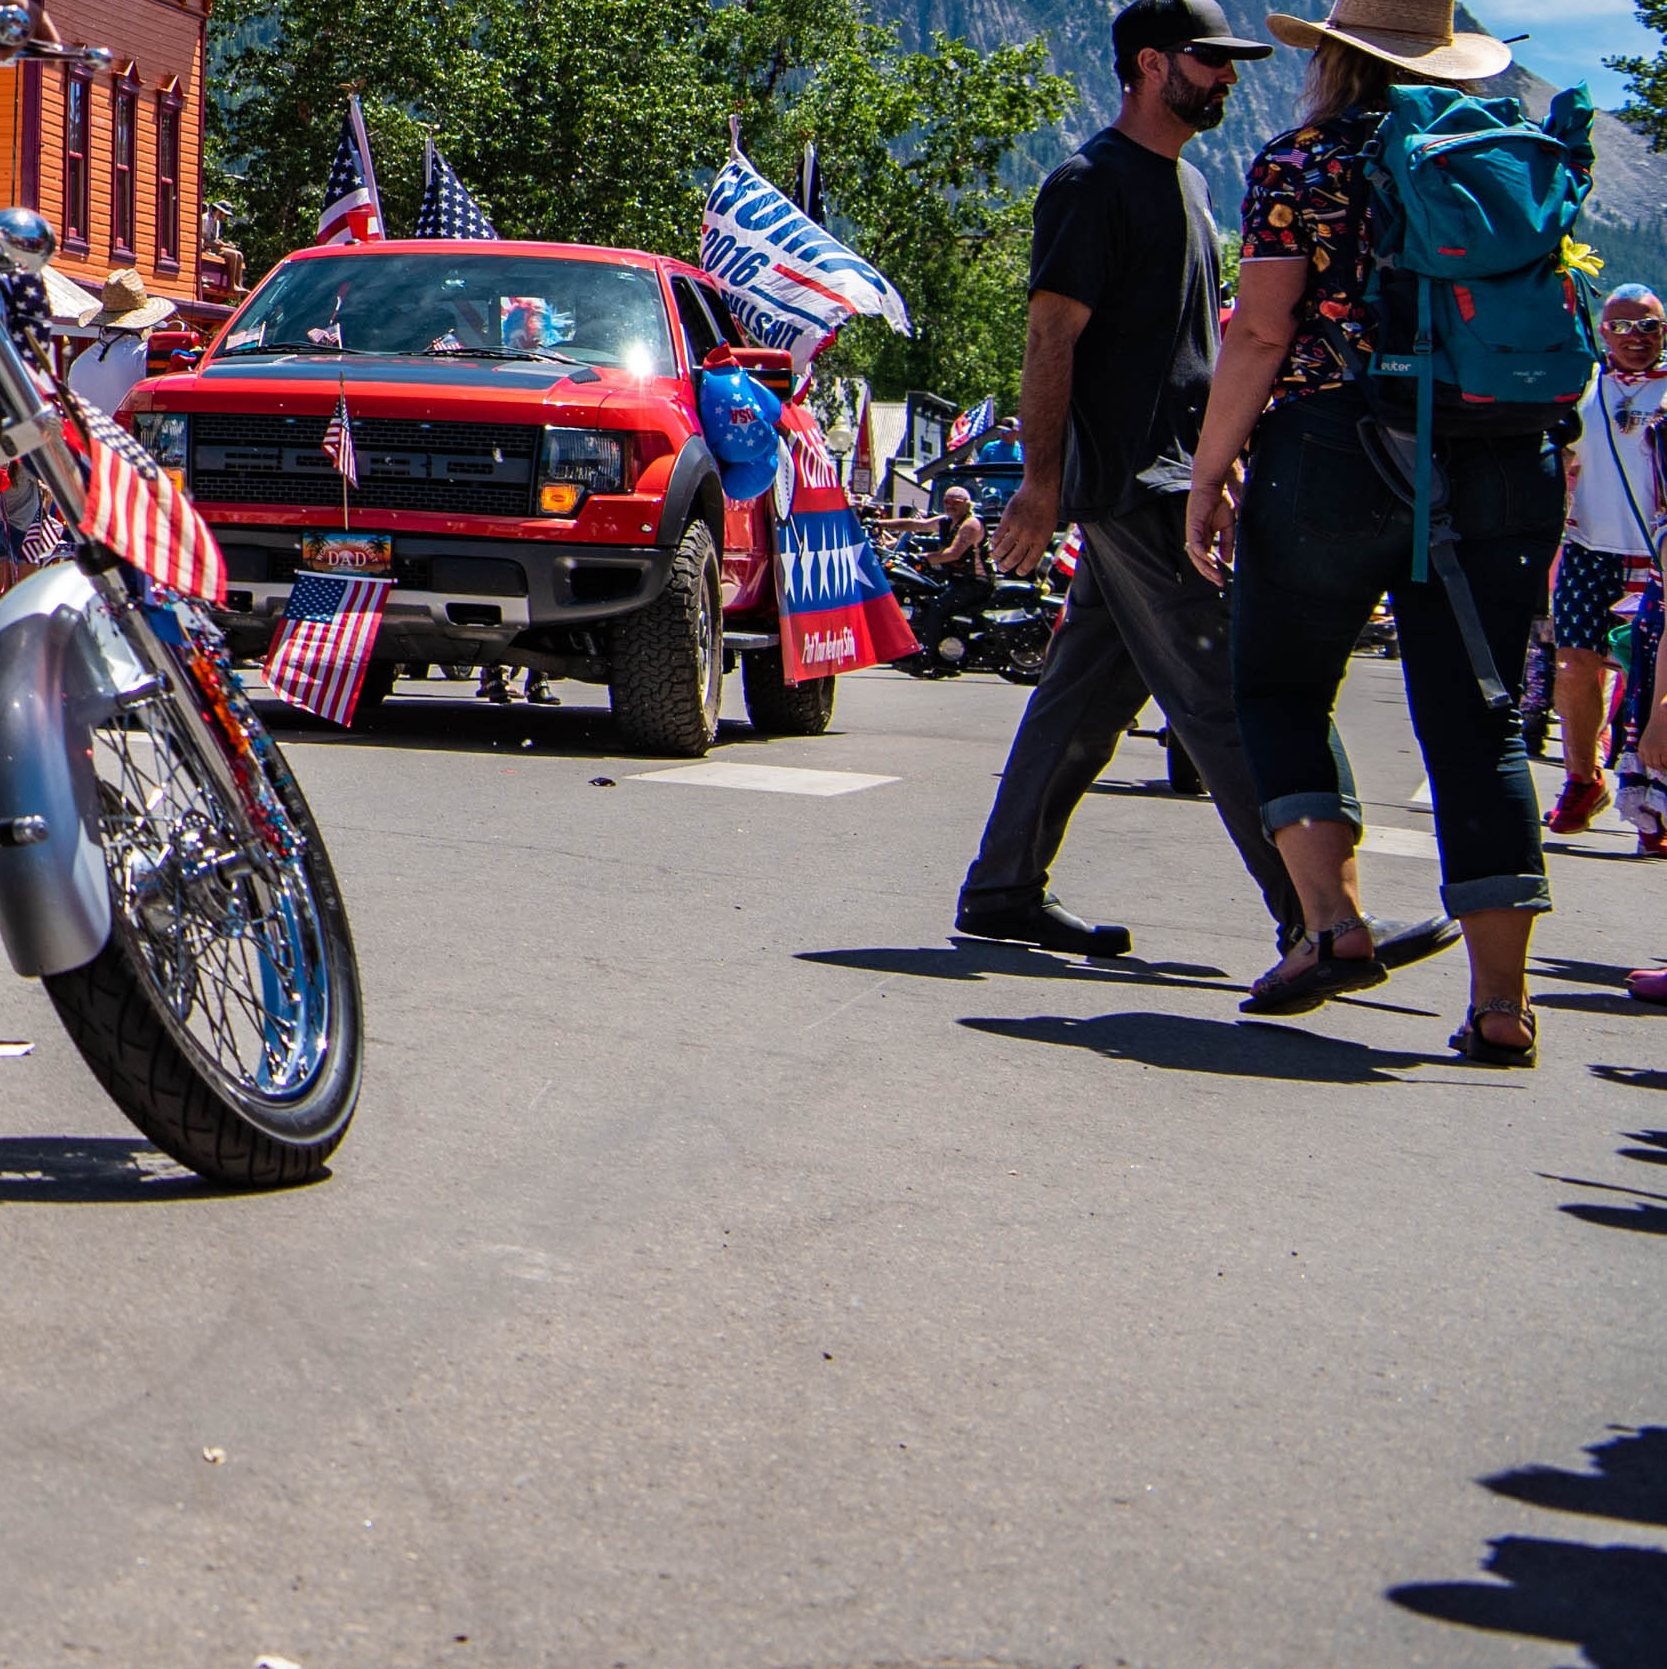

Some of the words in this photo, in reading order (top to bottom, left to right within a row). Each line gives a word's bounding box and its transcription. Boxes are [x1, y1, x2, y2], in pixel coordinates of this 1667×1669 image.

[701, 227, 770, 287] 2016
[1380, 361, 1412, 372] euter
[328, 550, 367, 567] DAD
